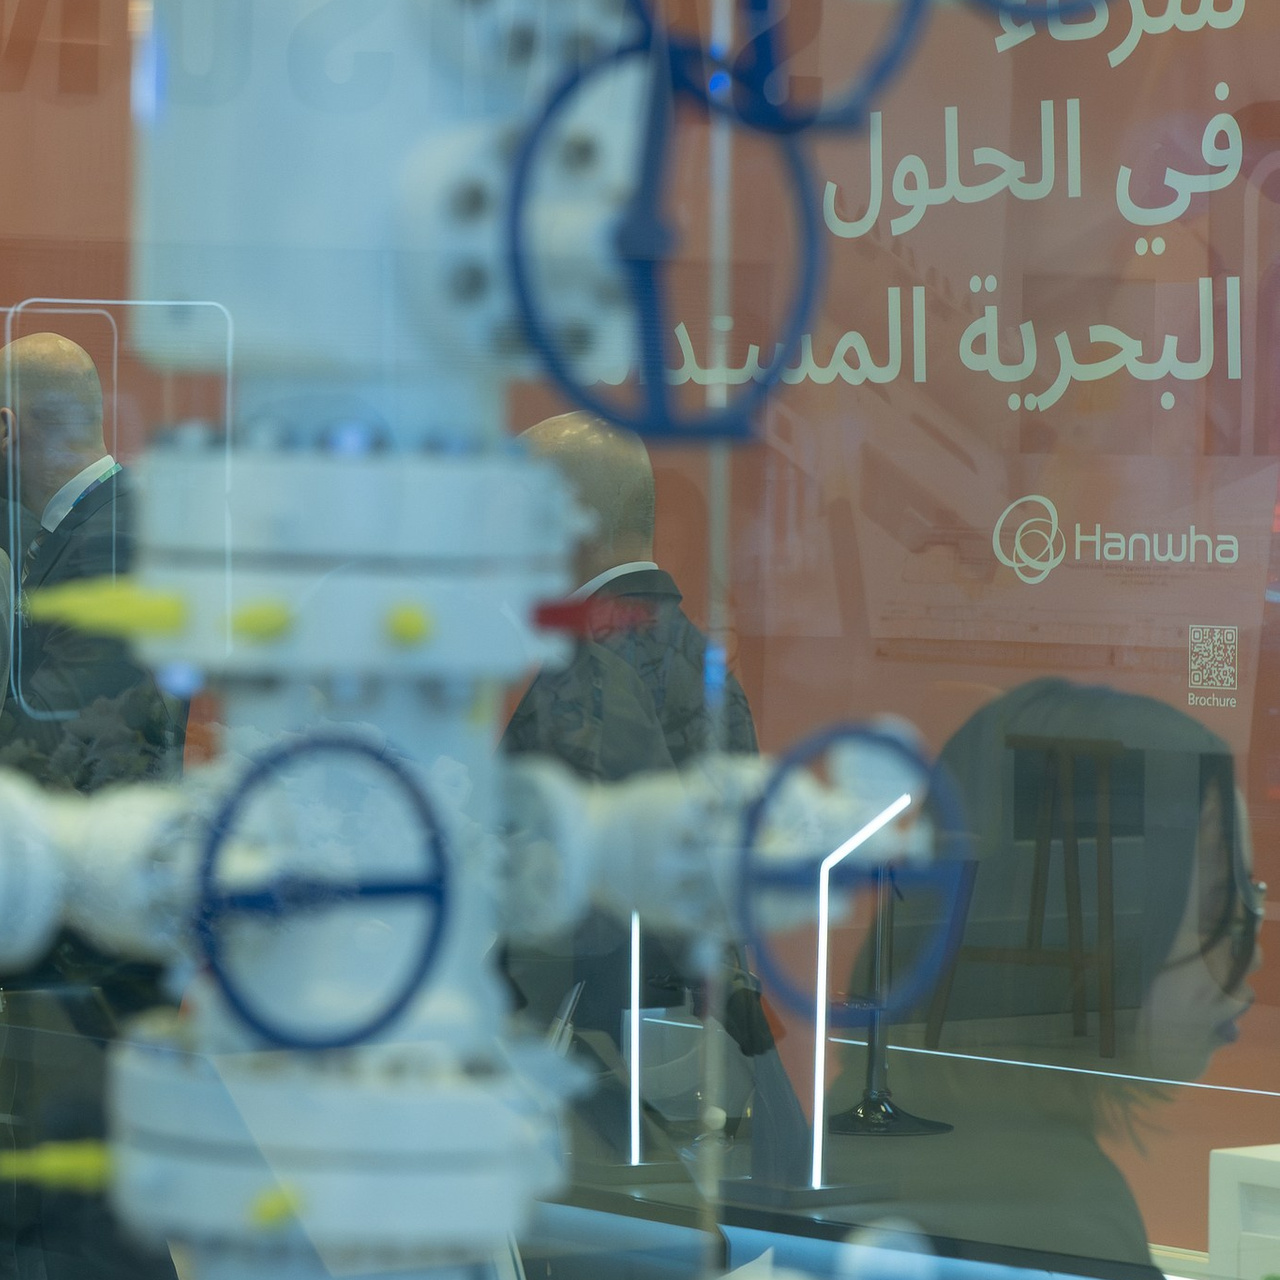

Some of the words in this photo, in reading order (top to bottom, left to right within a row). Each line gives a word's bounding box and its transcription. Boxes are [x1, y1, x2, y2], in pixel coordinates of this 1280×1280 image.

[824, 98, 1082, 240] الحلول
[1116, 81, 1245, 256] في
[958, 275, 1243, 412] البحرية
[1075, 523, 1239, 564] Hanwha
[1187, 692, 1237, 708] Brochure
